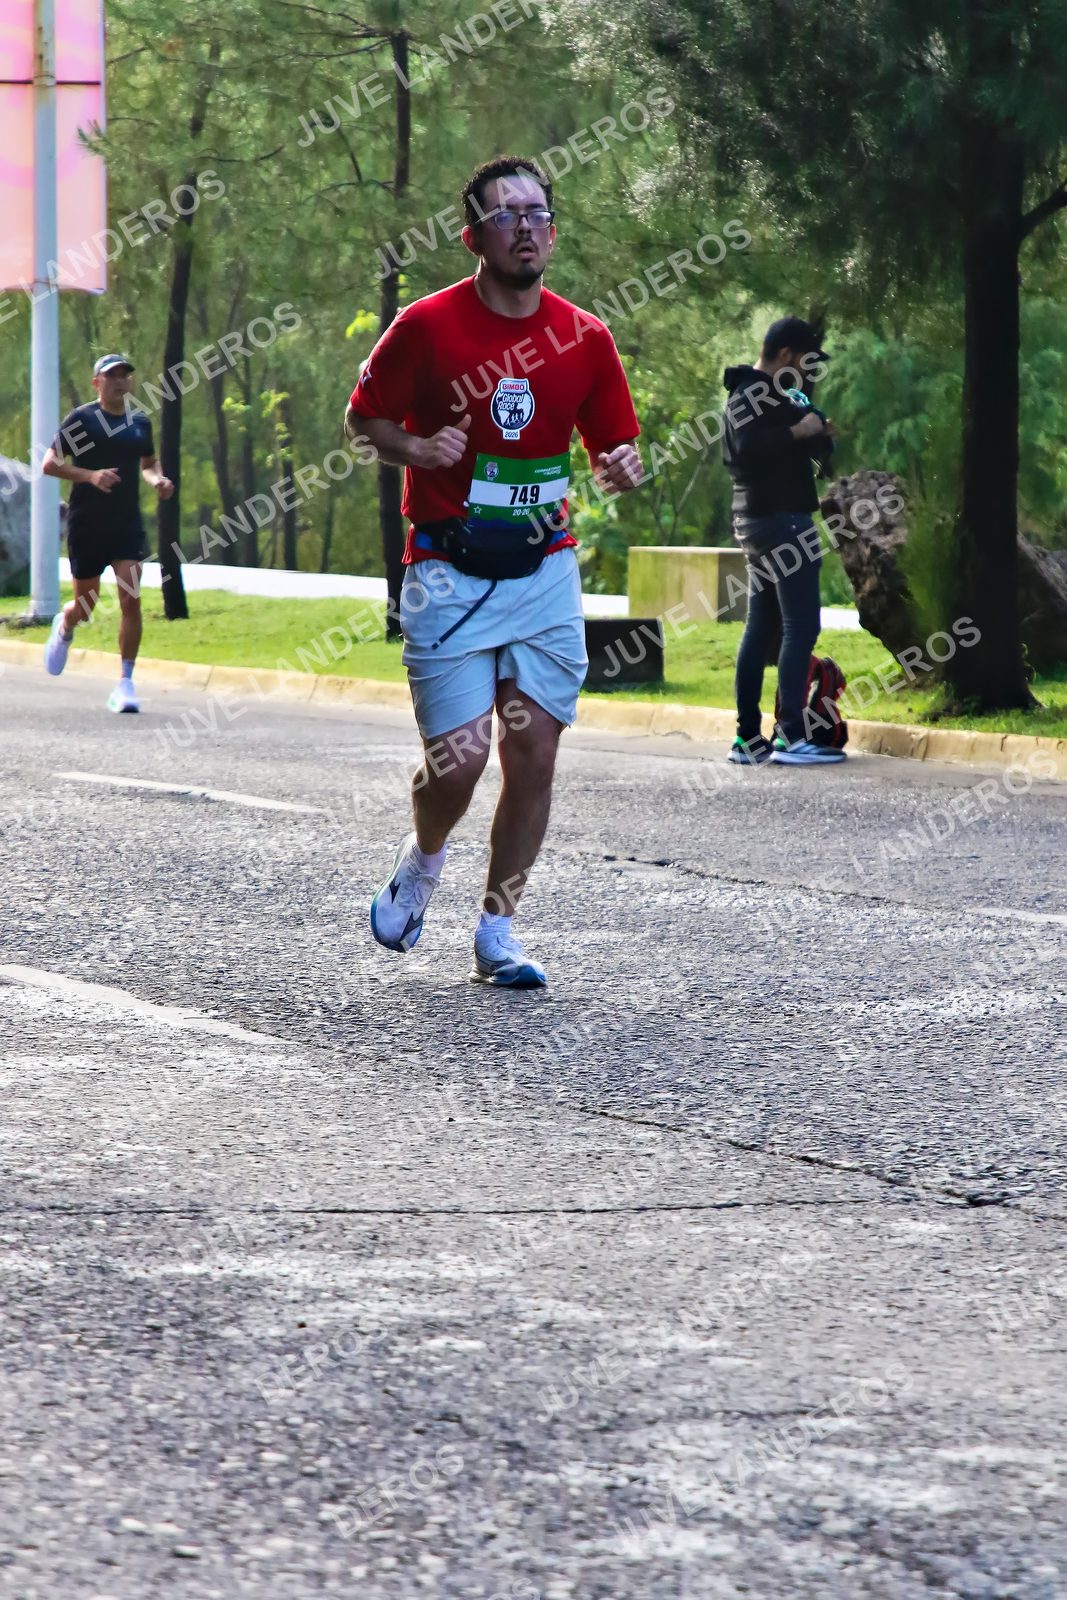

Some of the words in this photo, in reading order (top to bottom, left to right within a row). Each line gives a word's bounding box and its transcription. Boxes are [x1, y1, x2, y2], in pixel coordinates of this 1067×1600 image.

[502, 393, 525, 403] Global
[497, 401, 515, 410] Race
[509, 485, 541, 506] 749
